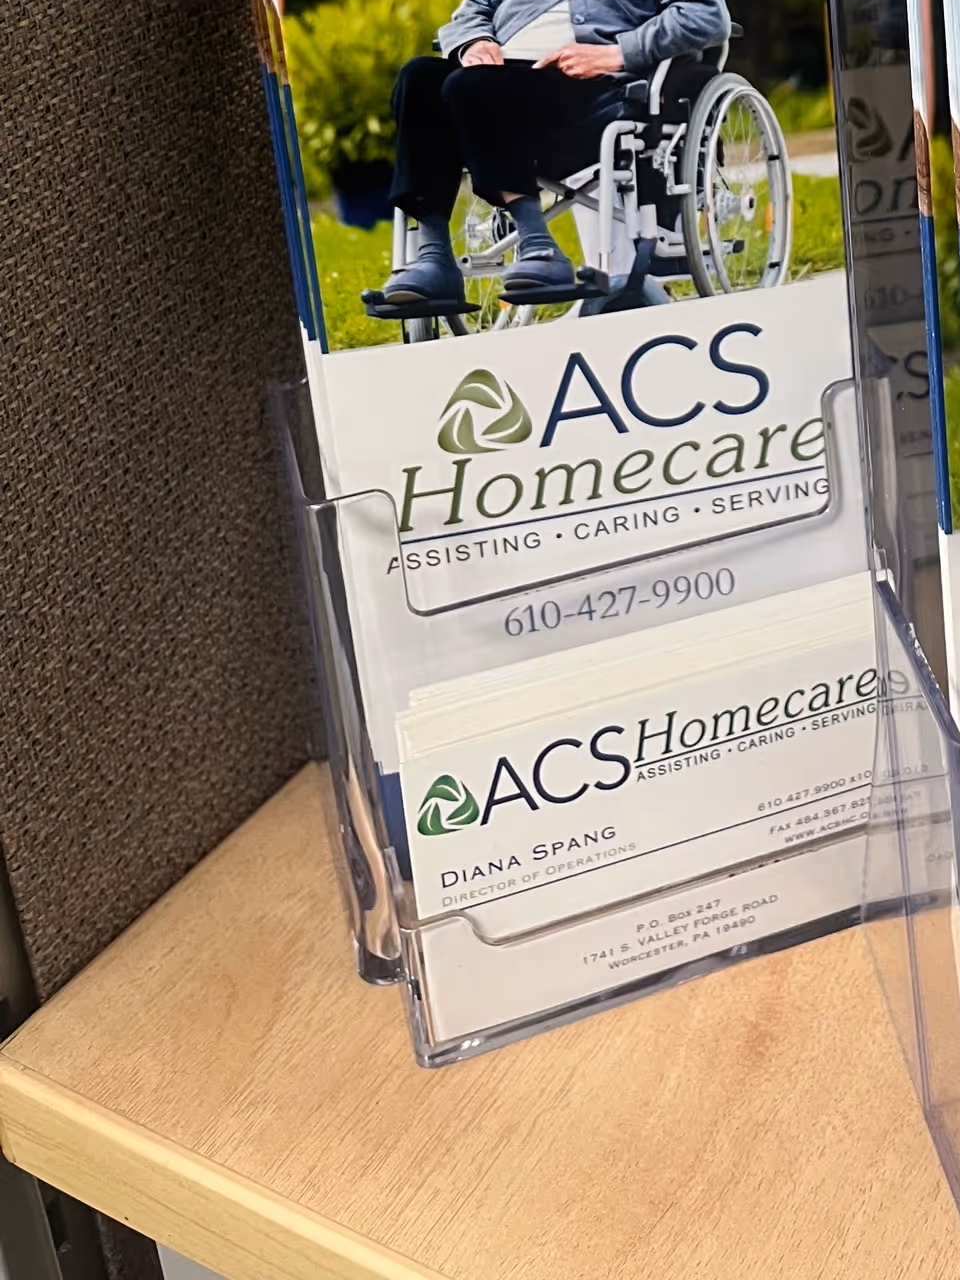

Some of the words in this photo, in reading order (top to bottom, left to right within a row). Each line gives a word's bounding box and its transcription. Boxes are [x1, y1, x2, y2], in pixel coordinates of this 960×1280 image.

[539, 322, 769, 448] ACS
[398, 417, 832, 532] Homecare
[574, 506, 681, 541] CARING
[712, 478, 829, 514] SERVING
[504, 567, 735, 637] 610-427-9900
[633, 668, 878, 763] Homecare
[637, 748, 721, 782] ASSISTING
[737, 727, 795, 753] CARING
[812, 702, 877, 731] SERVING
[480, 725, 631, 826] ACS
[441, 855, 521, 889] DIANA
[532, 826, 617, 861] SPANG
[441, 878, 517, 908] DIRECTOR
[522, 871, 540, 884] OF
[545, 842, 636, 876] OPERATIONS
[583, 947, 614, 965] 1741
[637, 923, 690, 947] VALLEY
[694, 906, 738, 929] FORGE
[742, 894, 780, 913] ROAD
[692, 930, 711, 943] PA
[696, 898, 721, 915] 247
